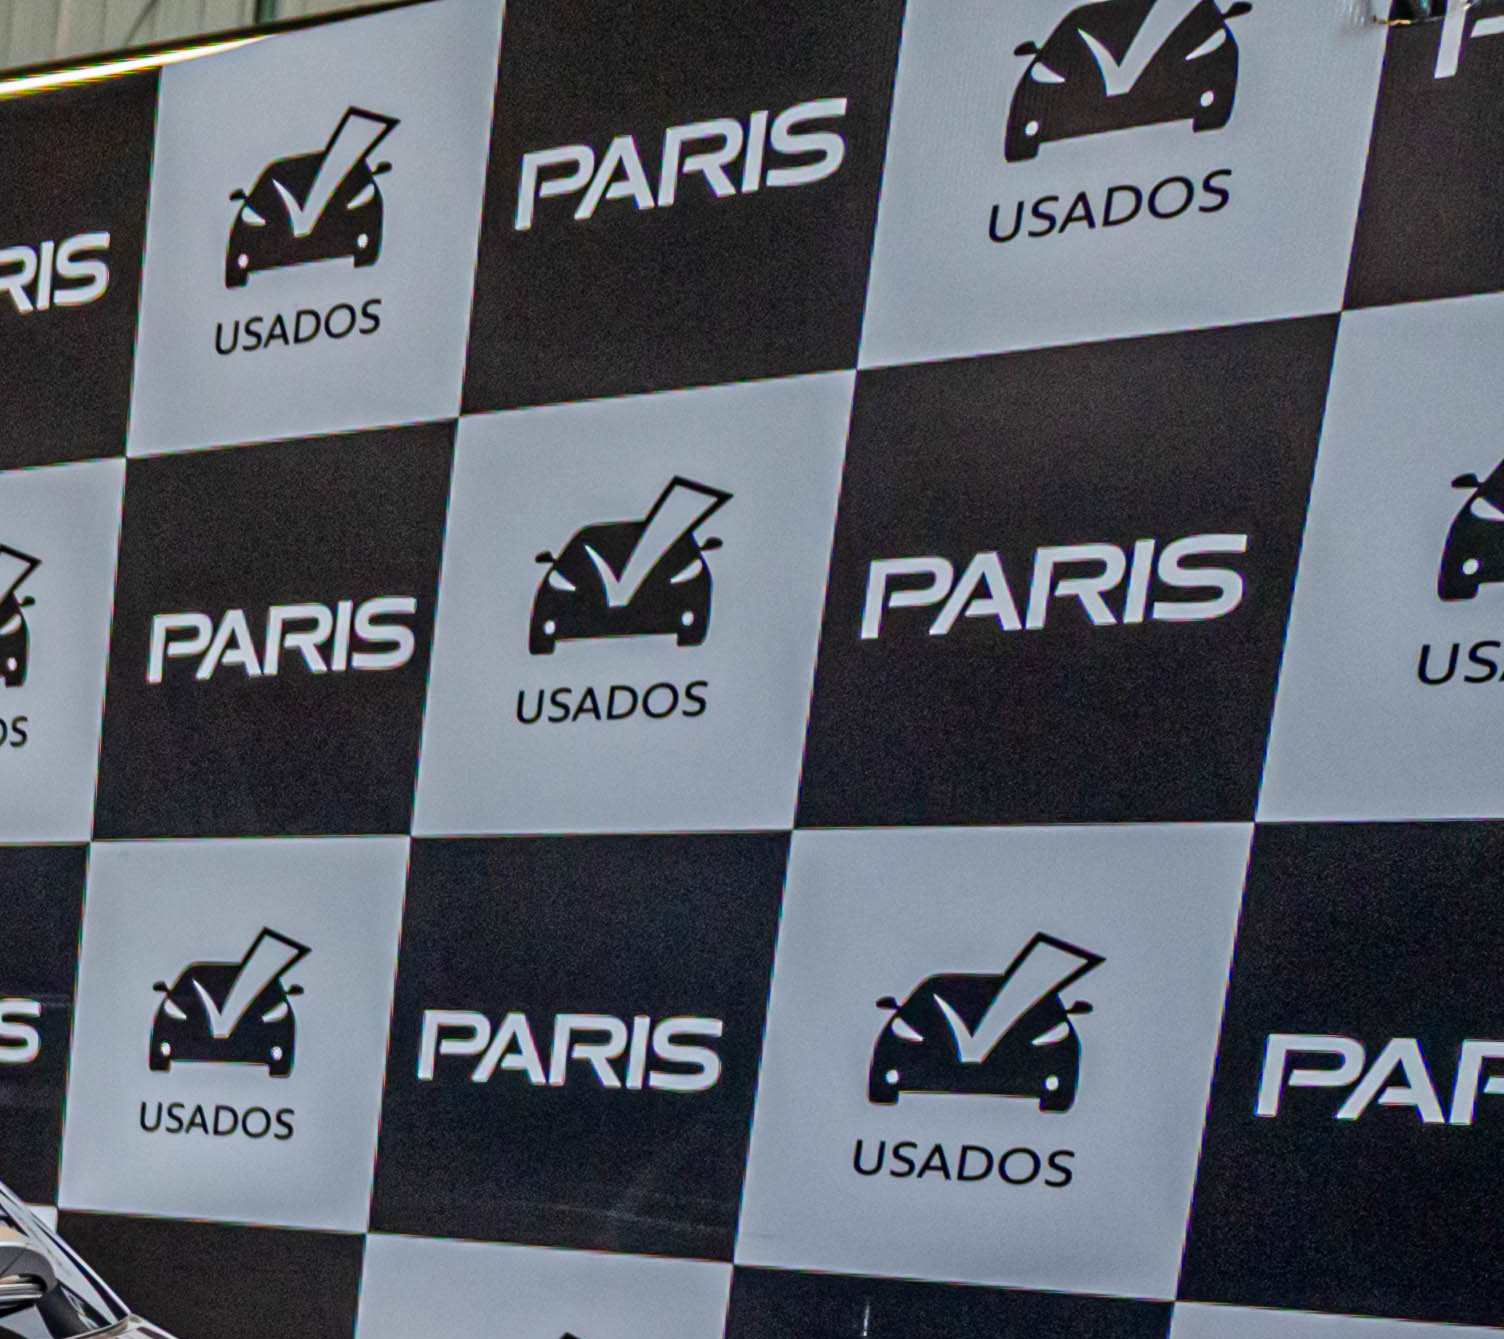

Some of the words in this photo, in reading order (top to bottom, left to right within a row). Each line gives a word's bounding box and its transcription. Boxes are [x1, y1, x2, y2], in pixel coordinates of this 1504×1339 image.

[514, 97, 847, 230] PARIS
[988, 169, 1232, 243] USADOS
[214, 299, 382, 355] USADOS
[860, 533, 1248, 639] PARIS
[146, 597, 416, 684] PARIS
[1418, 640, 1504, 685] US
[516, 680, 708, 724] USADOS
[417, 1010, 723, 1091] PARIS
[139, 1101, 295, 1140] USADOS
[853, 1140, 1075, 1188] USADOS
